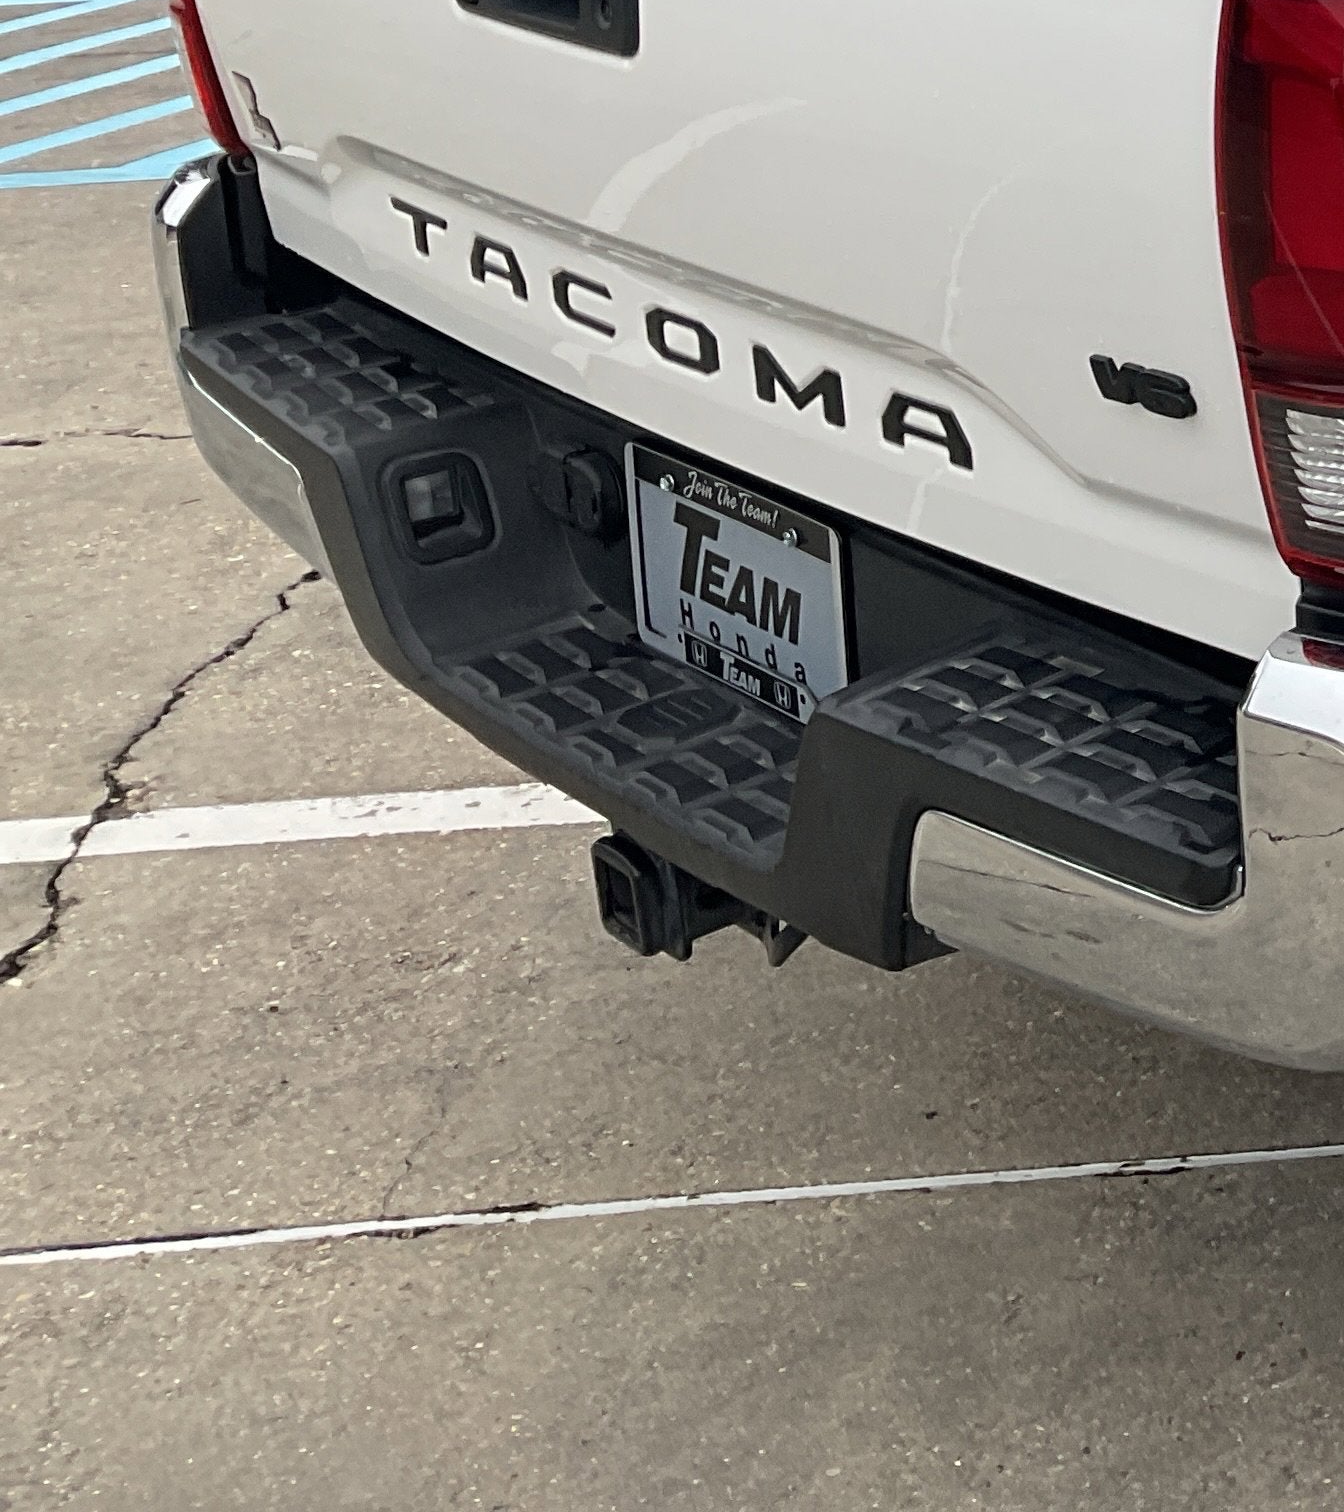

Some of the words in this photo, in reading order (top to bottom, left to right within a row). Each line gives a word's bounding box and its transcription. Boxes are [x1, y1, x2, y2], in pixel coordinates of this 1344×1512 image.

[389, 196, 975, 470] TACOMA
[1089, 353, 1199, 419] V6
[683, 471, 713, 499] Join
[714, 481, 738, 510] The
[738, 492, 779, 528] Team!
[672, 501, 802, 646] TEAM
[679, 598, 808, 686] Honda
[719, 651, 761, 696] TEAM
